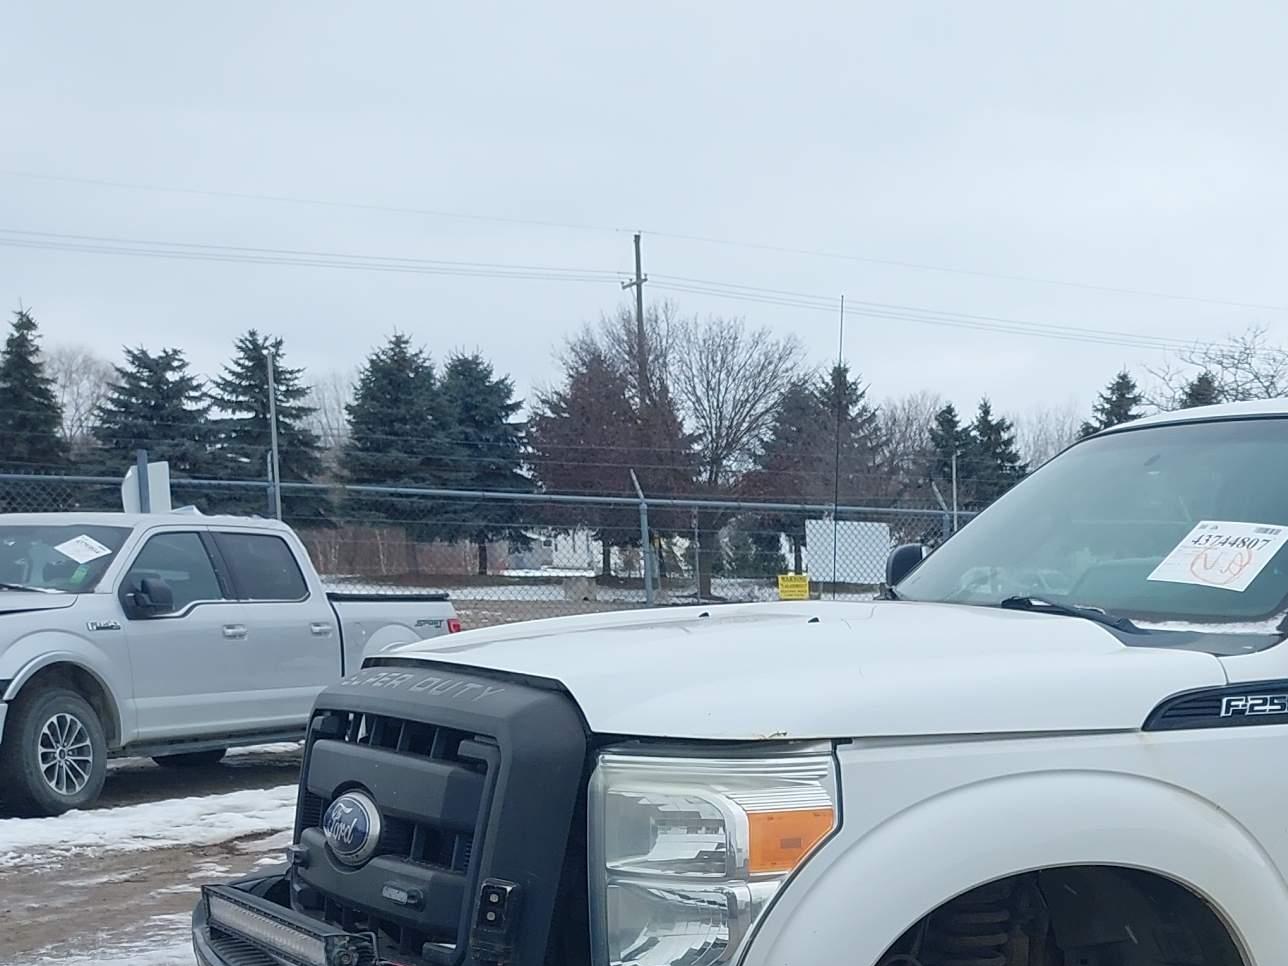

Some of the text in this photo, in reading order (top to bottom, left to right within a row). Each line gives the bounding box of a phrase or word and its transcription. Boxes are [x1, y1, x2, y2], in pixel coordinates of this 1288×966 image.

[1191, 534, 1272, 551] 43744807
[408, 676, 505, 702] DUTY
[327, 802, 358, 845] Ford
